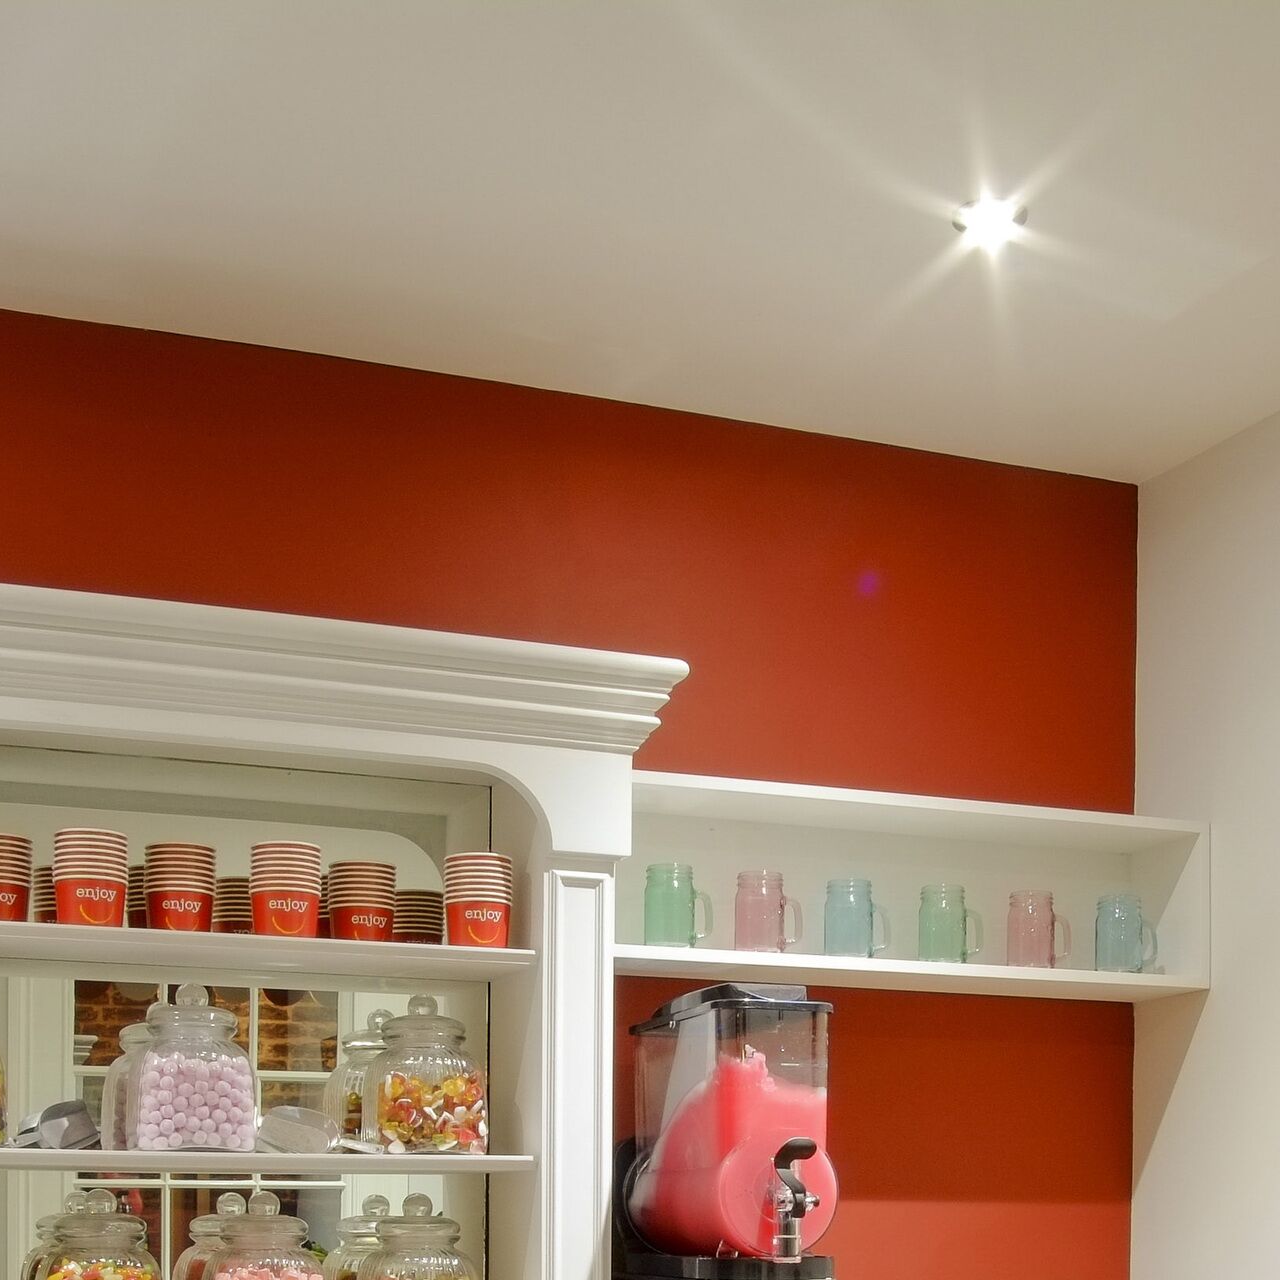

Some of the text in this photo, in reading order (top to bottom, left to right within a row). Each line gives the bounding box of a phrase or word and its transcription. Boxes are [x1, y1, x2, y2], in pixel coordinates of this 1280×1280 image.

[76, 886, 117, 901] enjoy
[162, 898, 202, 913] enjoy
[269, 898, 308, 913] enjoy
[351, 913, 387, 928] enjoy
[465, 908, 502, 921] enjoy
